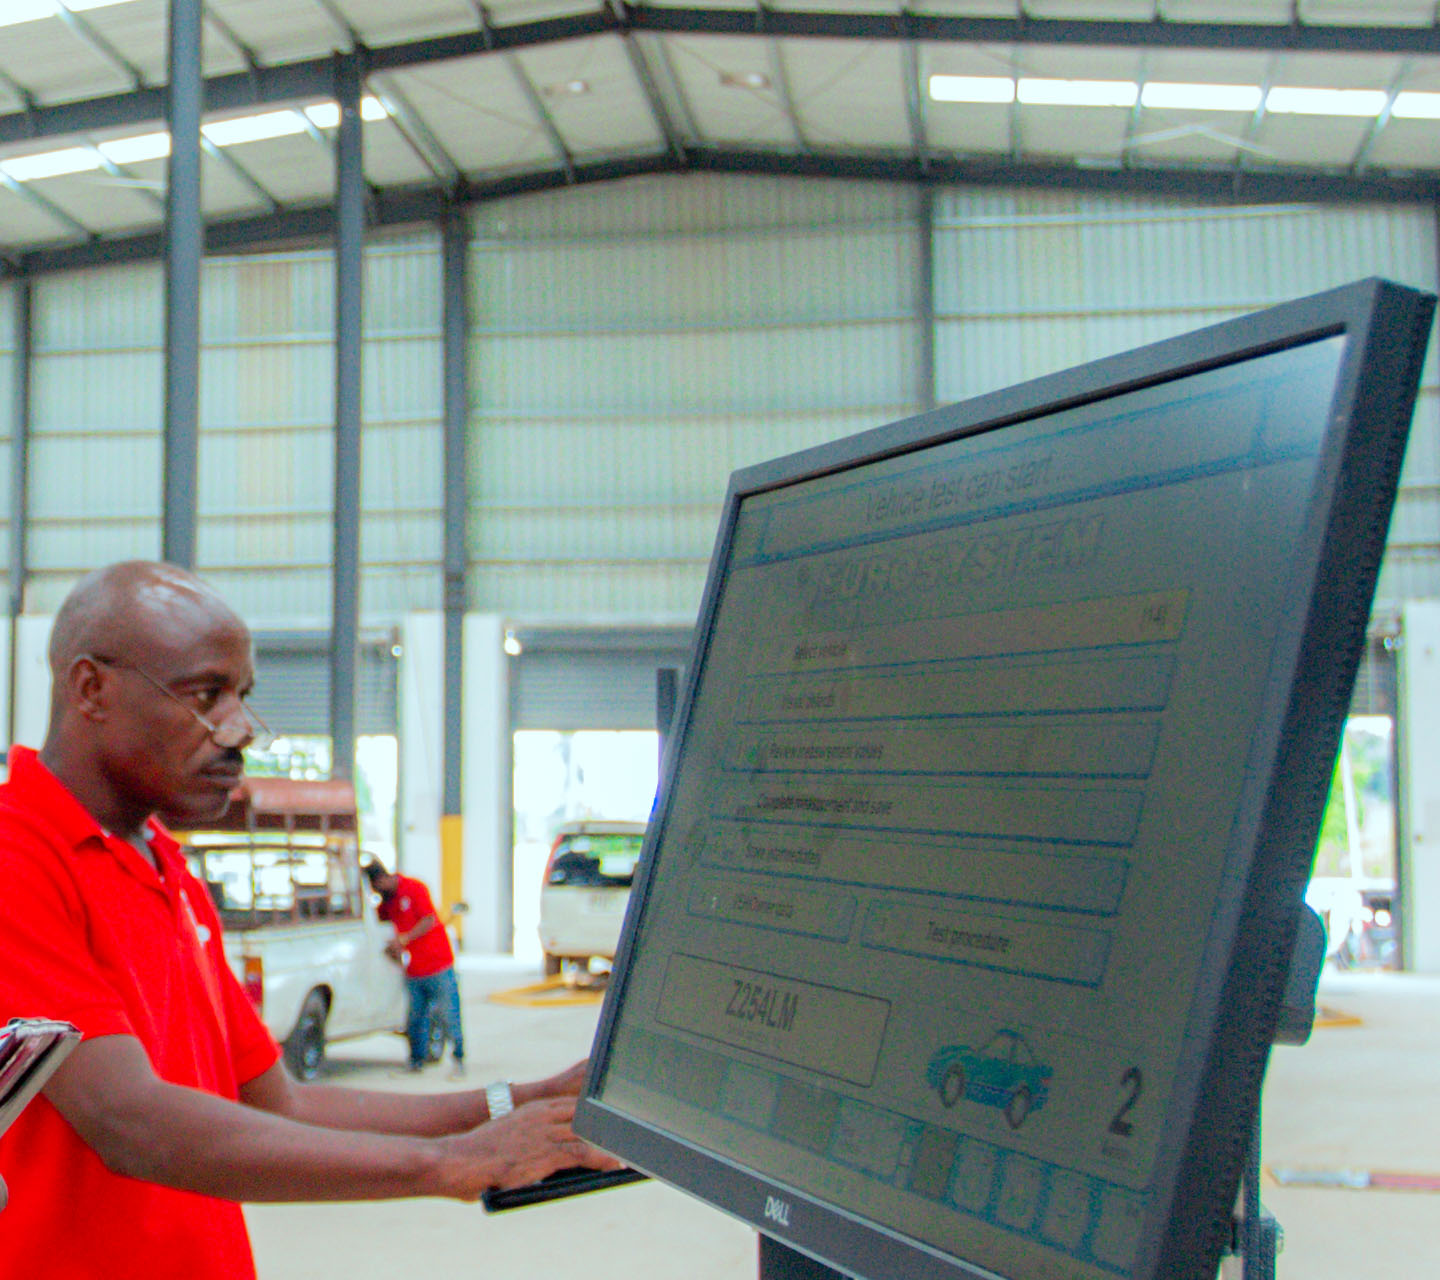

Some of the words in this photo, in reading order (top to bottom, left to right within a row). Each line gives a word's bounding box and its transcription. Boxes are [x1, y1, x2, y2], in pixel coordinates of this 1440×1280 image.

[865, 488, 923, 523] Vehicle
[927, 477, 961, 510] test
[966, 471, 1001, 502] can
[1007, 454, 1054, 491] start
[725, 978, 800, 1033] Z254LM
[1108, 1066, 1144, 1138] 2
[764, 1195, 790, 1227] DELL
